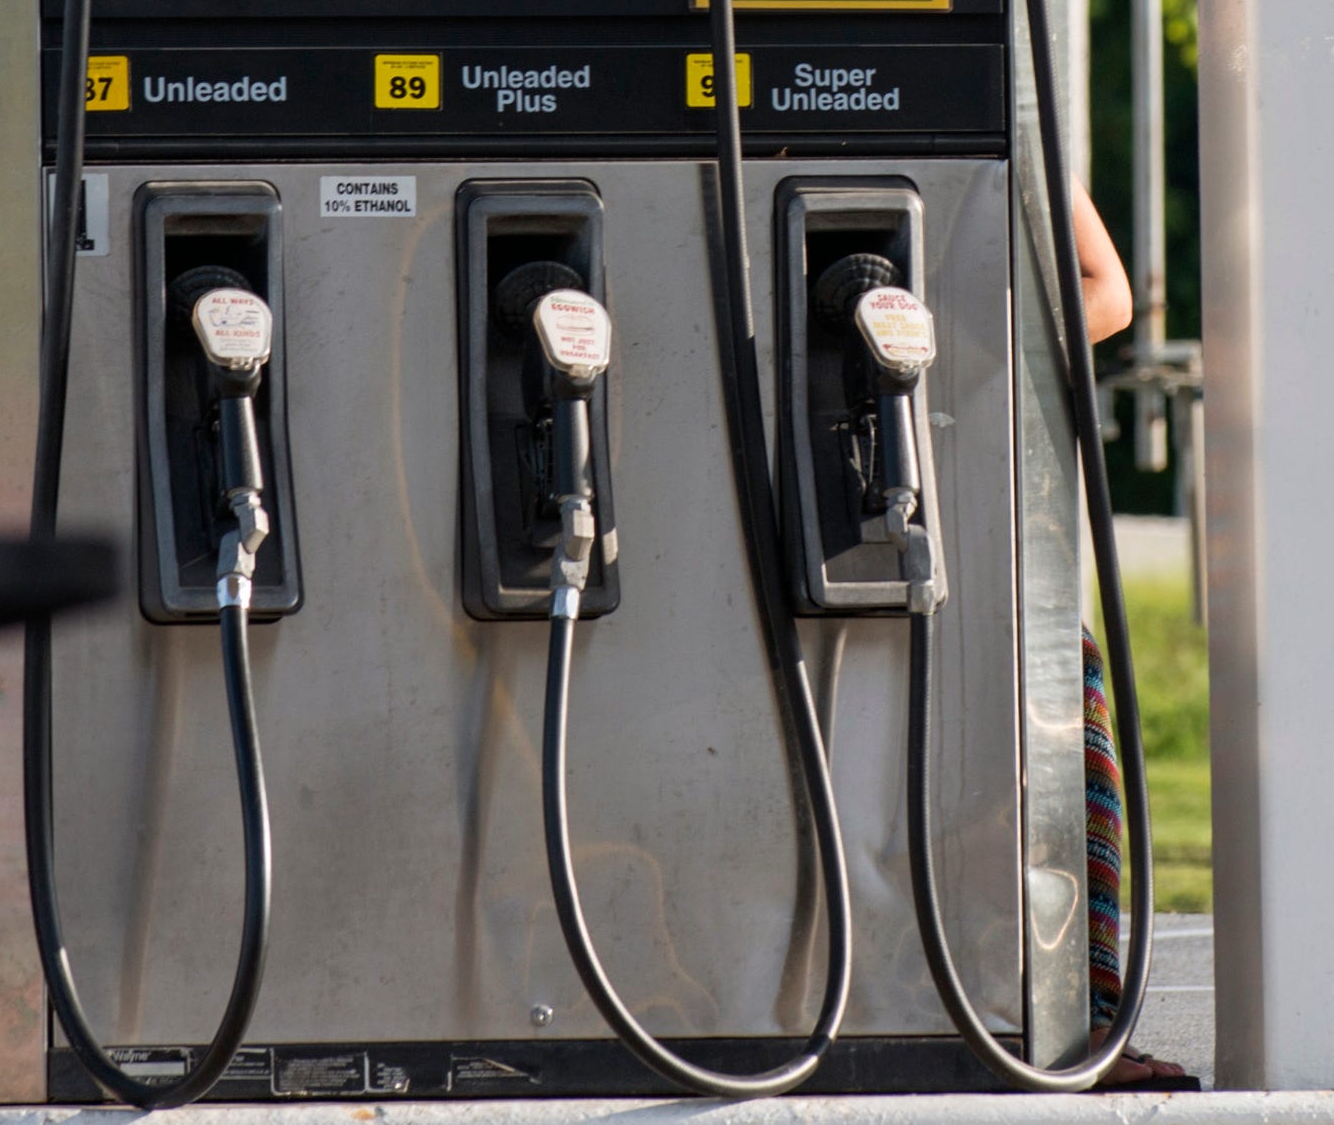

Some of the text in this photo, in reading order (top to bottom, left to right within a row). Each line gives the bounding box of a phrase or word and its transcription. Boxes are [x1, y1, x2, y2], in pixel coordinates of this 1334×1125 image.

[389, 76, 426, 100] 89
[462, 65, 591, 89] Unleaded
[794, 63, 876, 91] Super
[143, 77, 287, 102] Unleaded
[497, 89, 557, 113] Plus
[772, 88, 900, 112] Unleaded
[337, 182, 399, 195] CONTAINS
[325, 200, 411, 212] 10% ETHANOL
